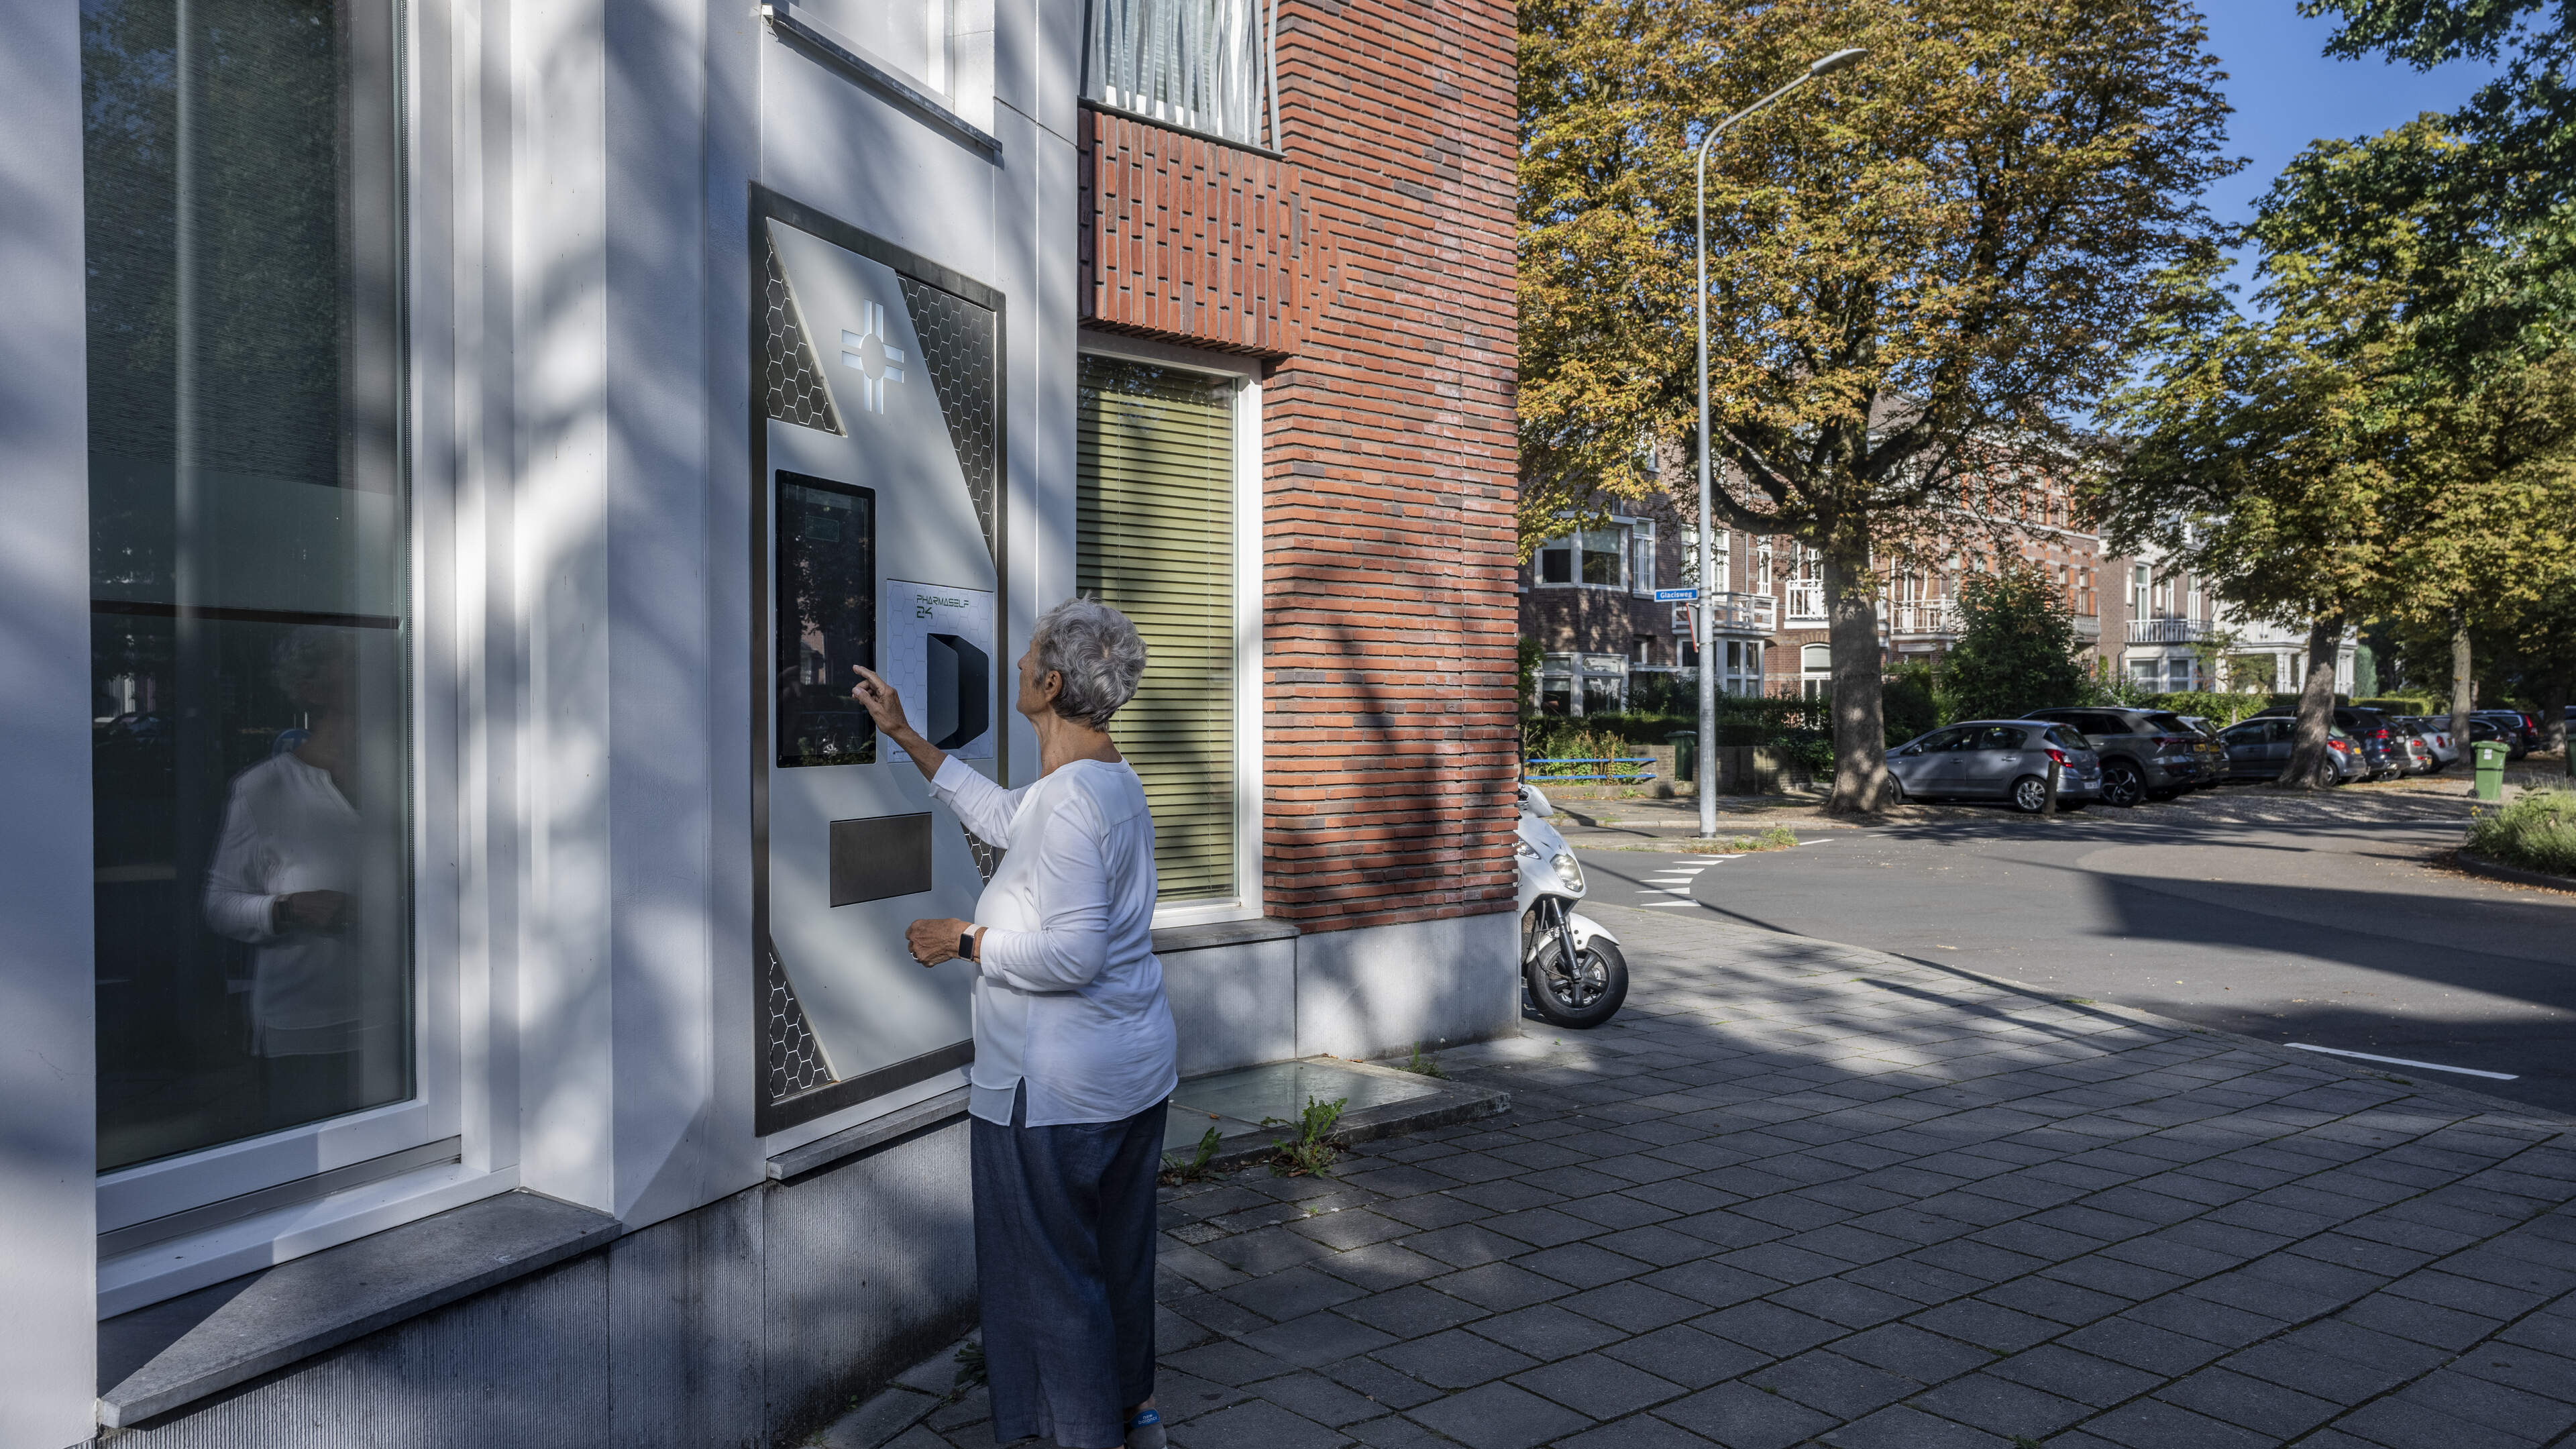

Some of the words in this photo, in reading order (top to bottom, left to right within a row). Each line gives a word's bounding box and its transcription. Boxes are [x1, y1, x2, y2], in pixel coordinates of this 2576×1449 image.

[916, 594, 969, 608] PHARMASELF
[1660, 591, 1693, 599] Glacisweg
[916, 606, 933, 619] 24
